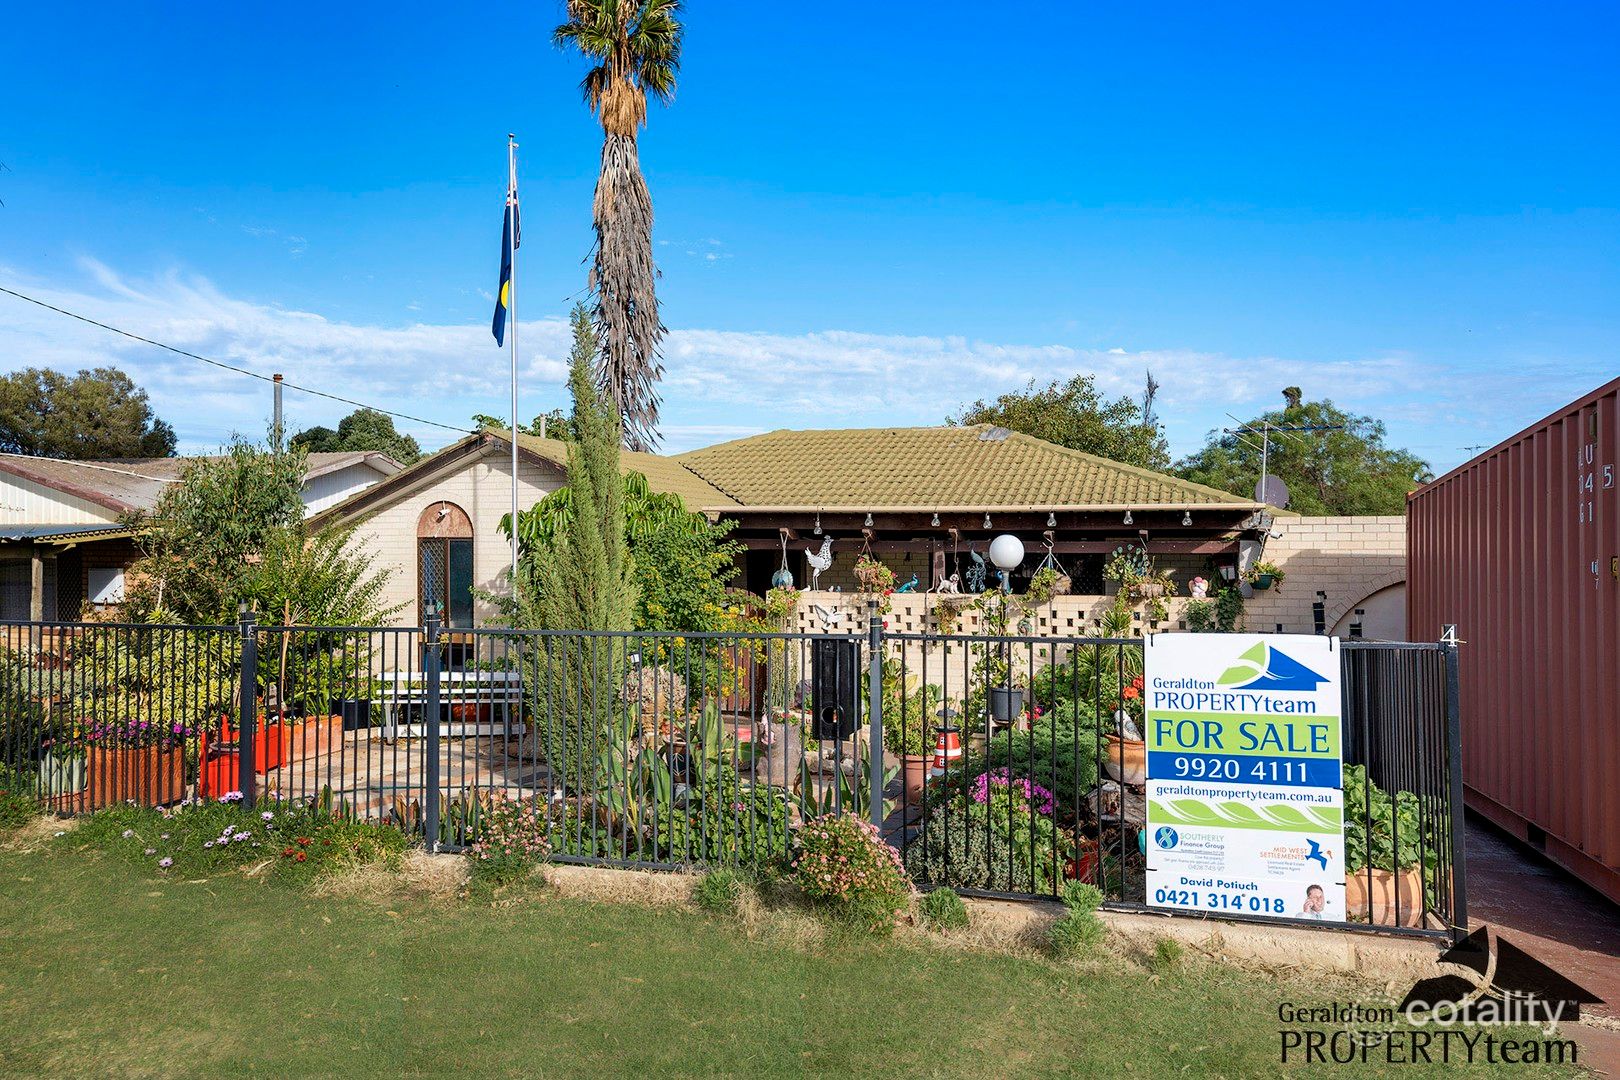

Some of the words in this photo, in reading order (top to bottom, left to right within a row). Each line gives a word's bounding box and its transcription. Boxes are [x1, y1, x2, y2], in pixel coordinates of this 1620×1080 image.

[1604, 466, 1613, 488] 5
[1440, 625, 1459, 648] 4
[1153, 677, 1214, 690] Geraldton
[1153, 691, 1316, 713] PROPERTYteam
[1153, 719, 1224, 749] FOR
[1239, 722, 1330, 753] SALE
[1174, 757, 1240, 779] 9920
[1250, 761, 1307, 782] 4111
[1156, 785, 1332, 803] geraldtonpropertyteam.com.au
[1180, 832, 1225, 842] SOUTHERLY
[1180, 840, 1203, 849] Finance
[1205, 842, 1225, 851] Group
[1260, 851, 1305, 860] SETTLEMENTS
[1289, 847, 1308, 855] WEST
[1180, 876, 1212, 888] David
[1217, 879, 1258, 891] Potiuch
[1155, 889, 1198, 906] 0421
[1208, 893, 1243, 909] 314
[1249, 896, 1285, 913] 018
